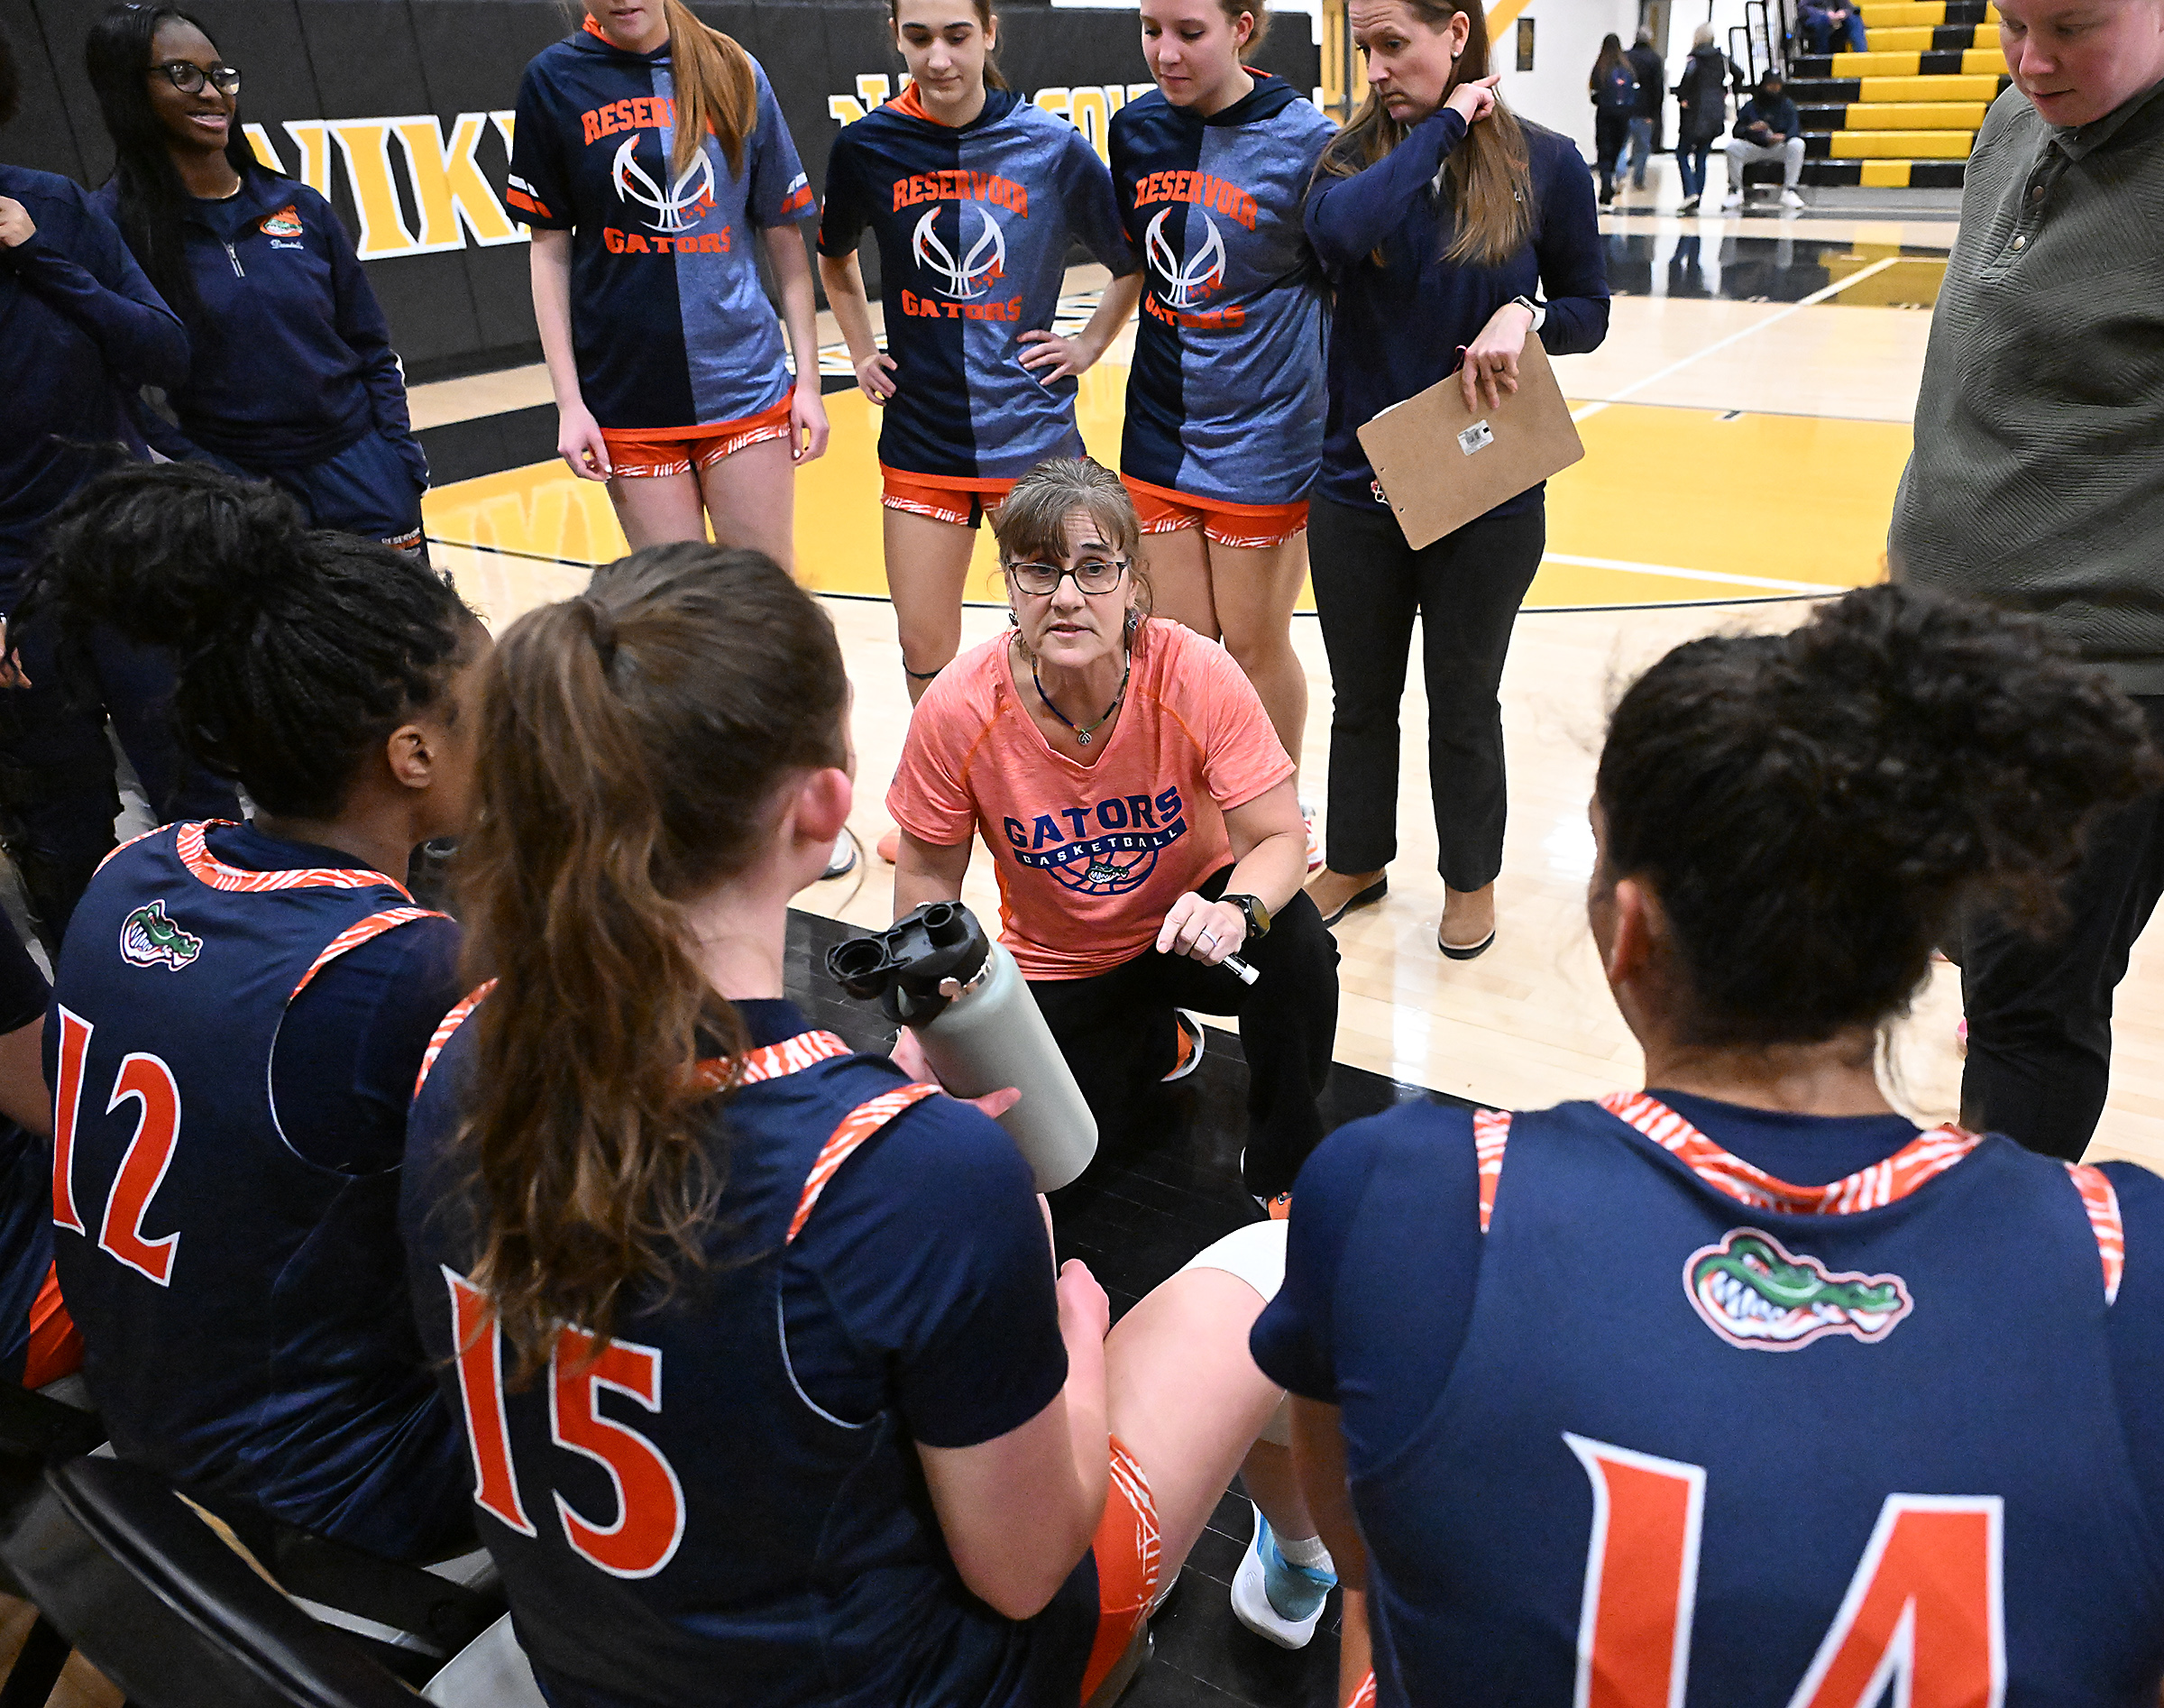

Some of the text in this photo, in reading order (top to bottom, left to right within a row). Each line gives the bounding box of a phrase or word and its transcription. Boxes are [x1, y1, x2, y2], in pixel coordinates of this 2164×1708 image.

[893, 170, 1029, 219] RESERVOIR
[1133, 170, 1259, 232] RESERVOIR
[603, 225, 731, 254] GATORS
[902, 289, 1023, 322] GATORS
[1004, 785, 1183, 849] GATORS
[1022, 829, 1178, 866] BASKETBALL
[52, 1004, 181, 1287] 12
[440, 1263, 687, 1580] 15
[1562, 1430, 2007, 1708] 14
